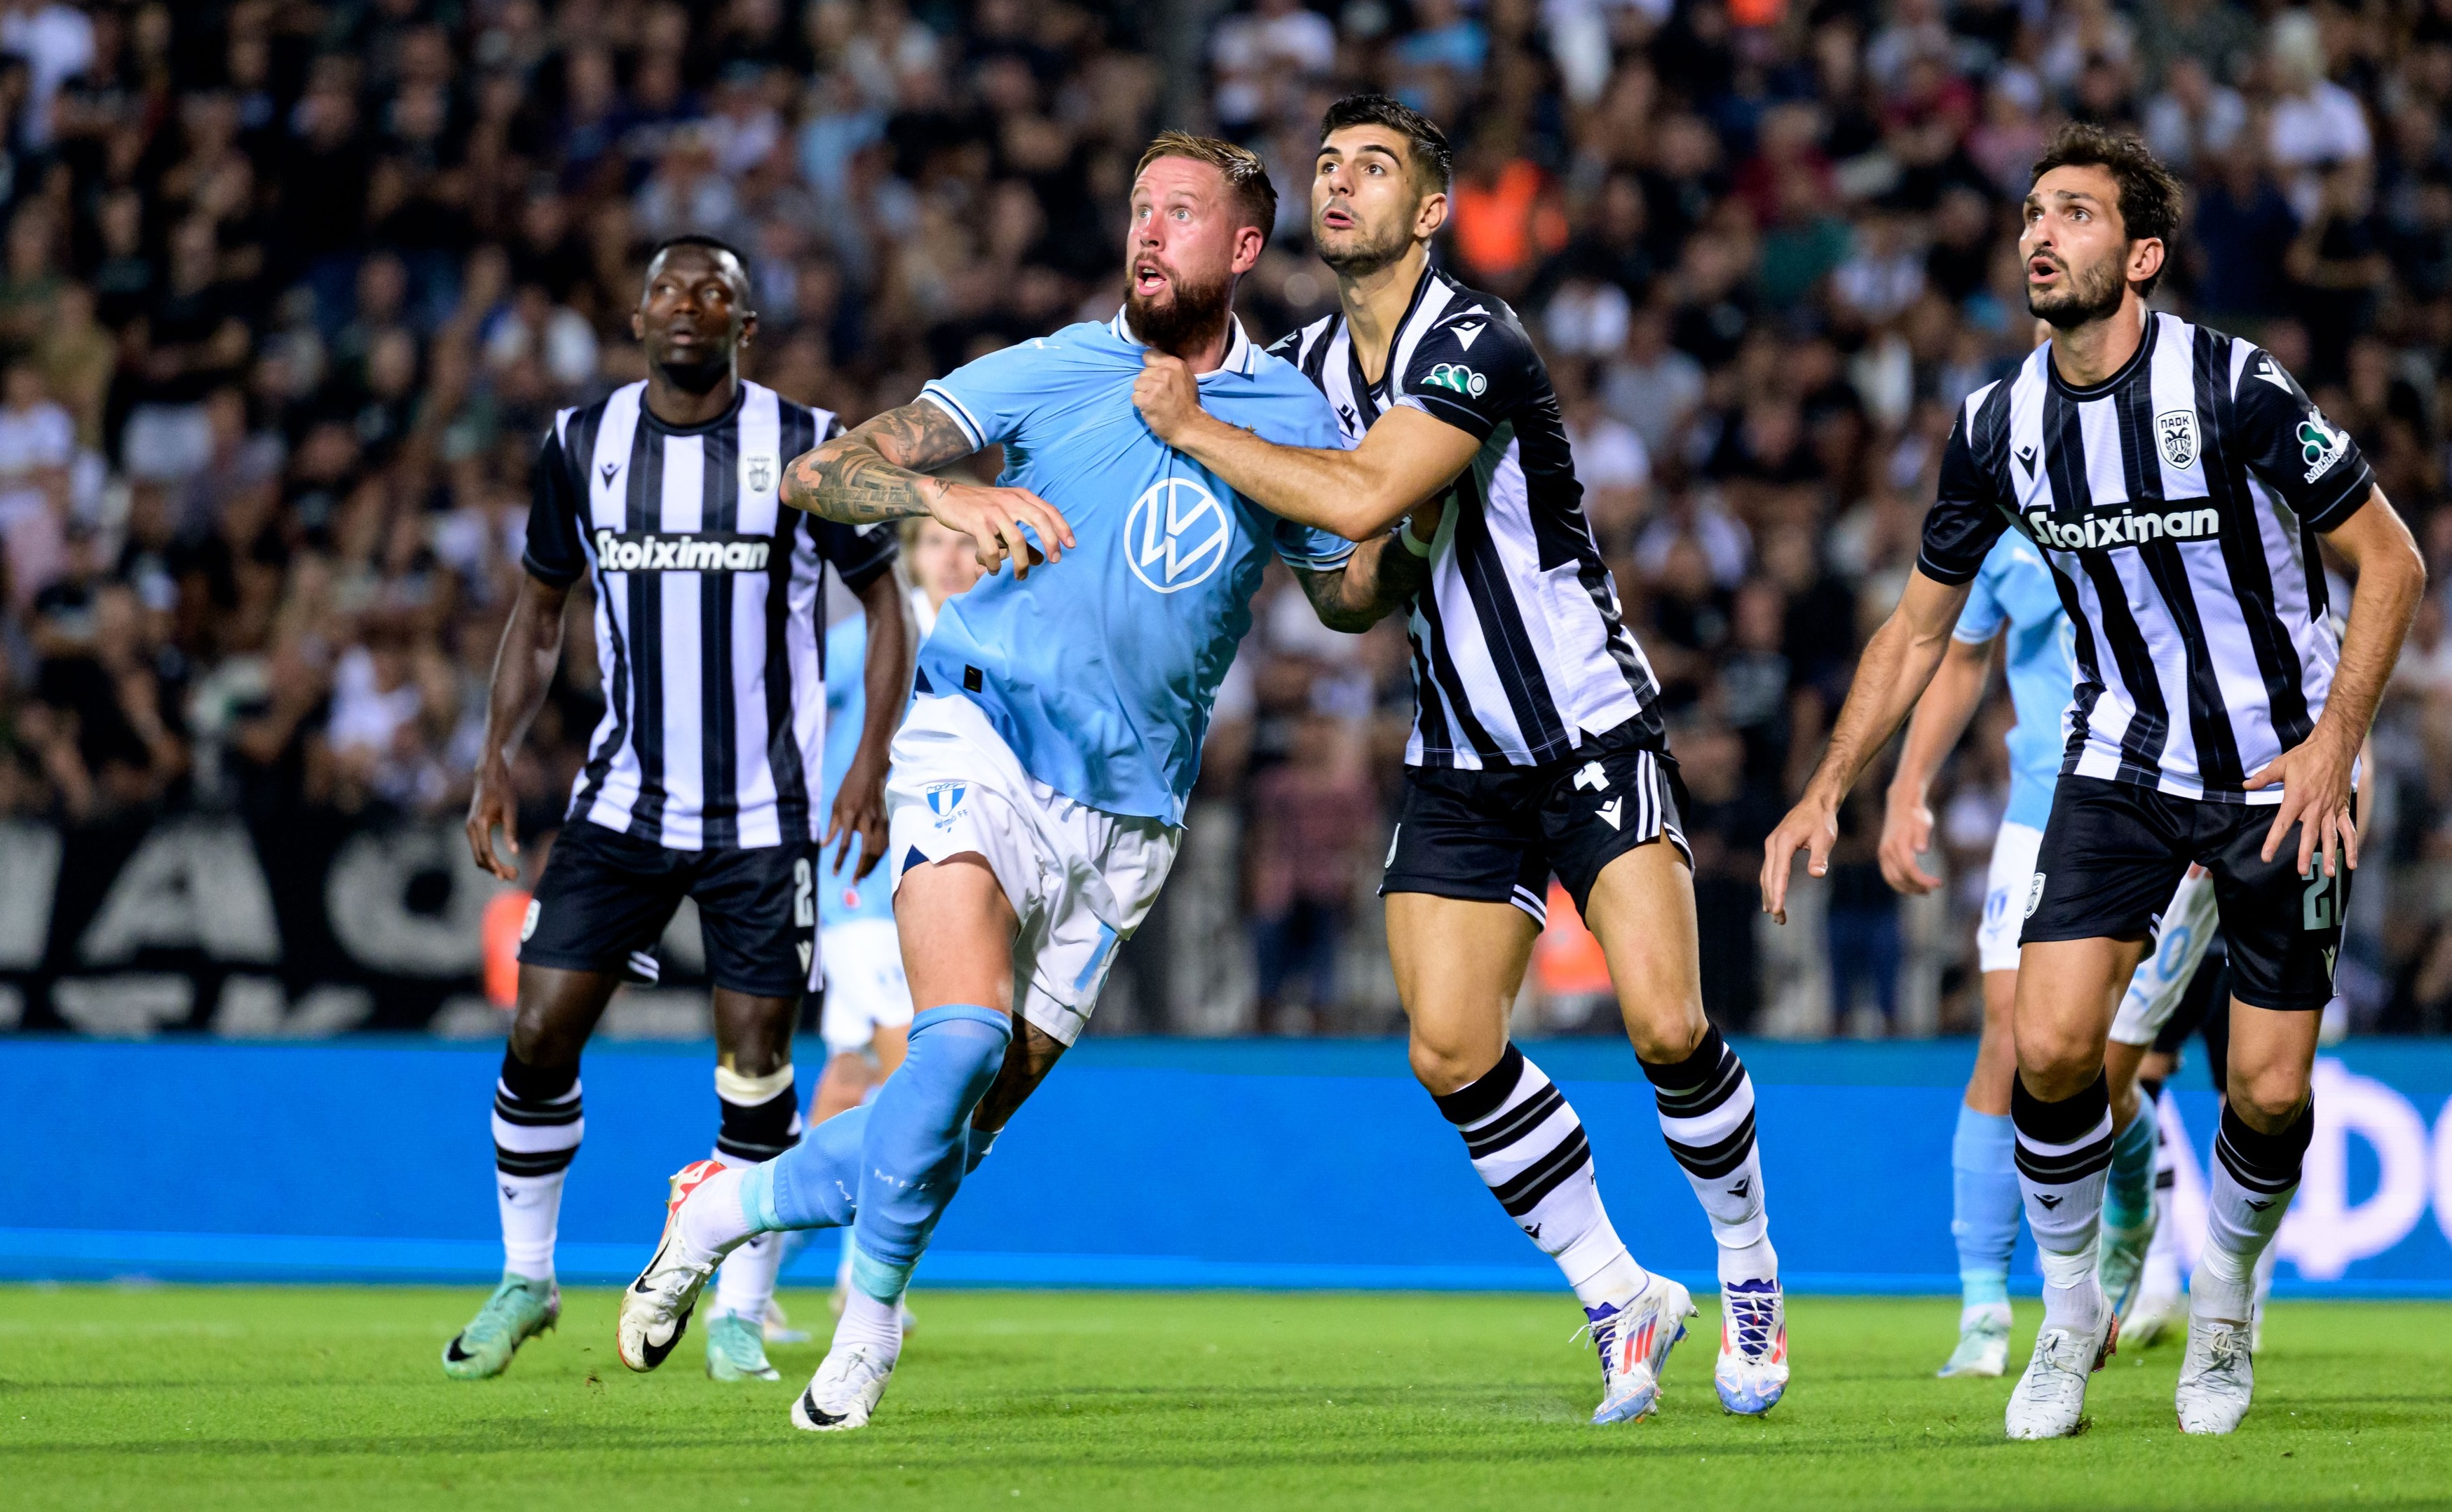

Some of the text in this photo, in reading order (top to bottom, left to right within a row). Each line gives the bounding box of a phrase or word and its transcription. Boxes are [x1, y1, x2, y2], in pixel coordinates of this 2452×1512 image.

[2029, 508, 2219, 549] Stoiximan
[597, 529, 770, 571] Stoiximan
[794, 857, 815, 927] 2
